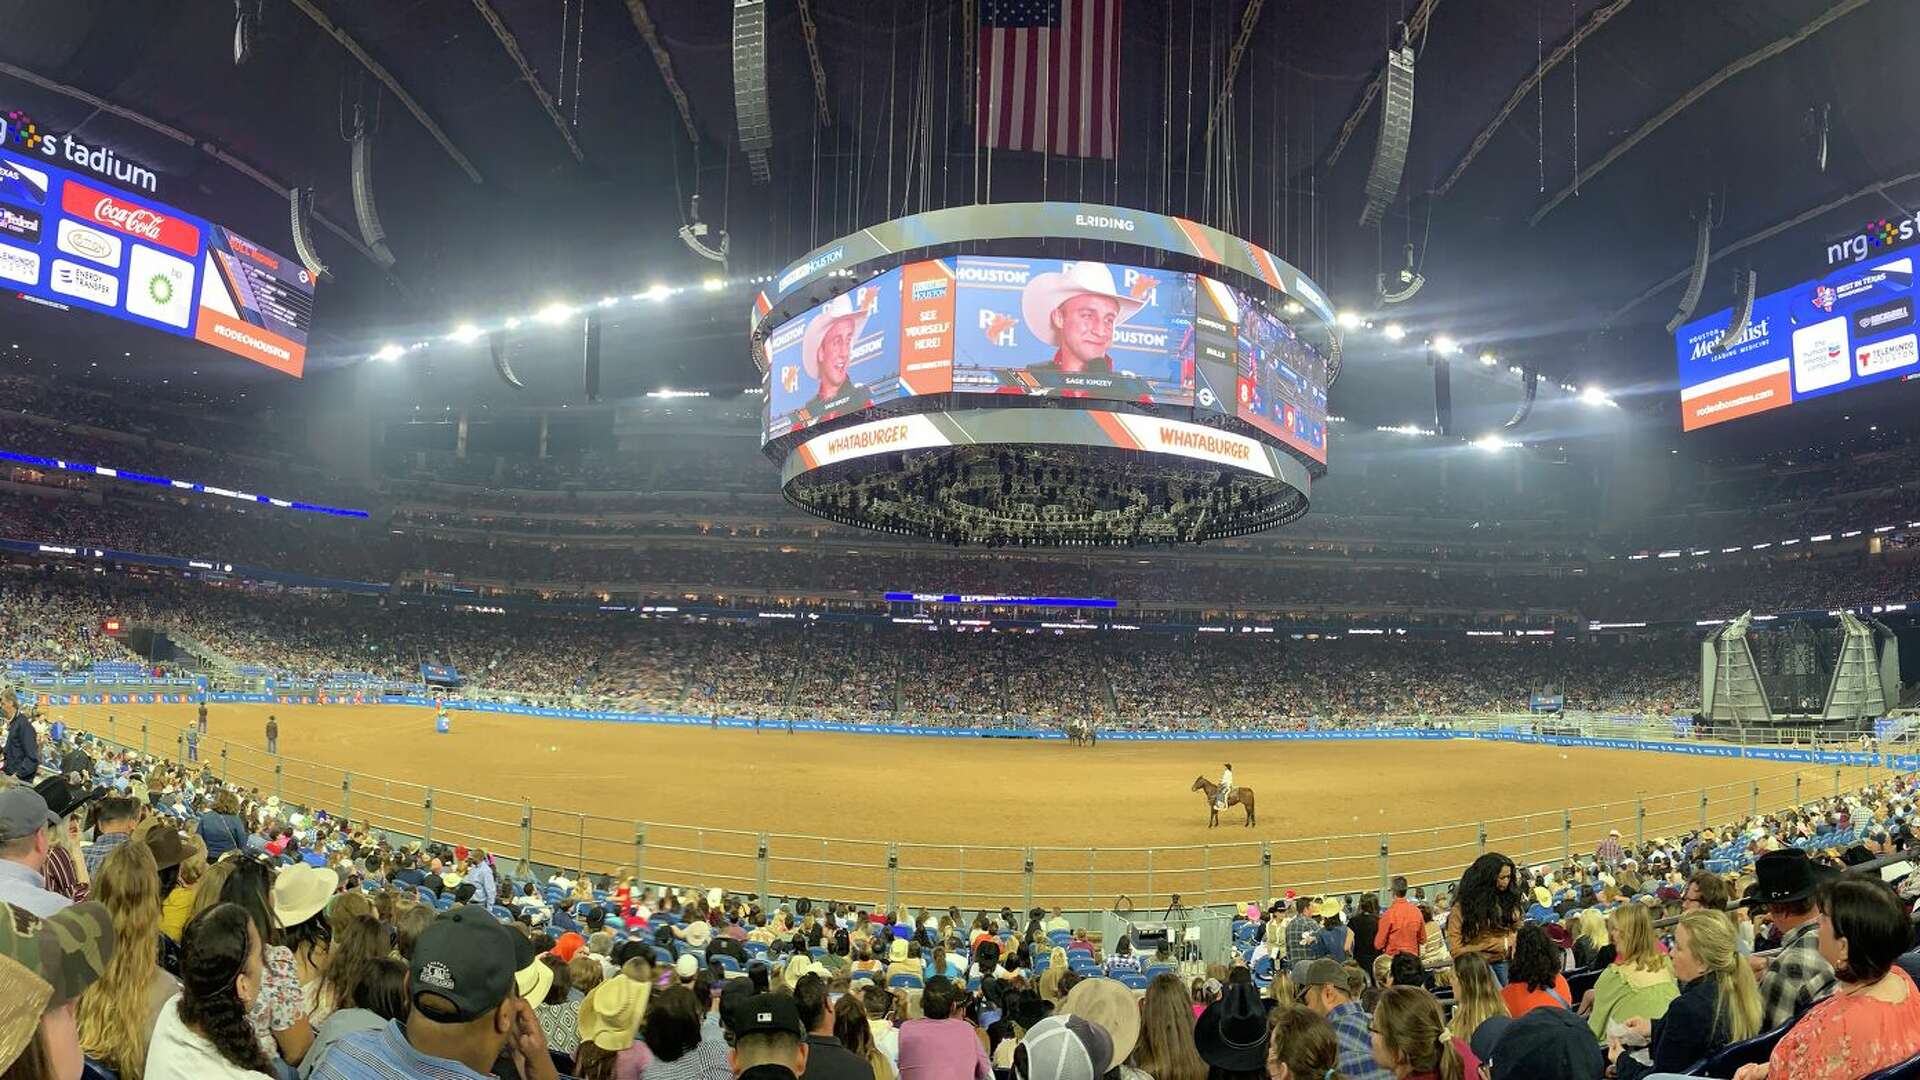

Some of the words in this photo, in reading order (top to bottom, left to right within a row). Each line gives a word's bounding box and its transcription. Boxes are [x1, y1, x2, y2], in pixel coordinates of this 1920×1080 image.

[1827, 234, 1868, 264] nrg
[76, 268, 102, 283] ENERGY
[76, 277, 109, 294] TRANSFER
[919, 310, 938, 321] SEE
[905, 322, 951, 337] YOURSELF
[914, 338, 941, 350] HERE!
[1873, 340, 1914, 357] TELEMUNDO
[1065, 377, 1086, 387] SAGE
[1241, 383, 1248, 402] 8
[827, 424, 909, 456] WHATABURGER
[1159, 426, 1250, 461] WHATABURGER
